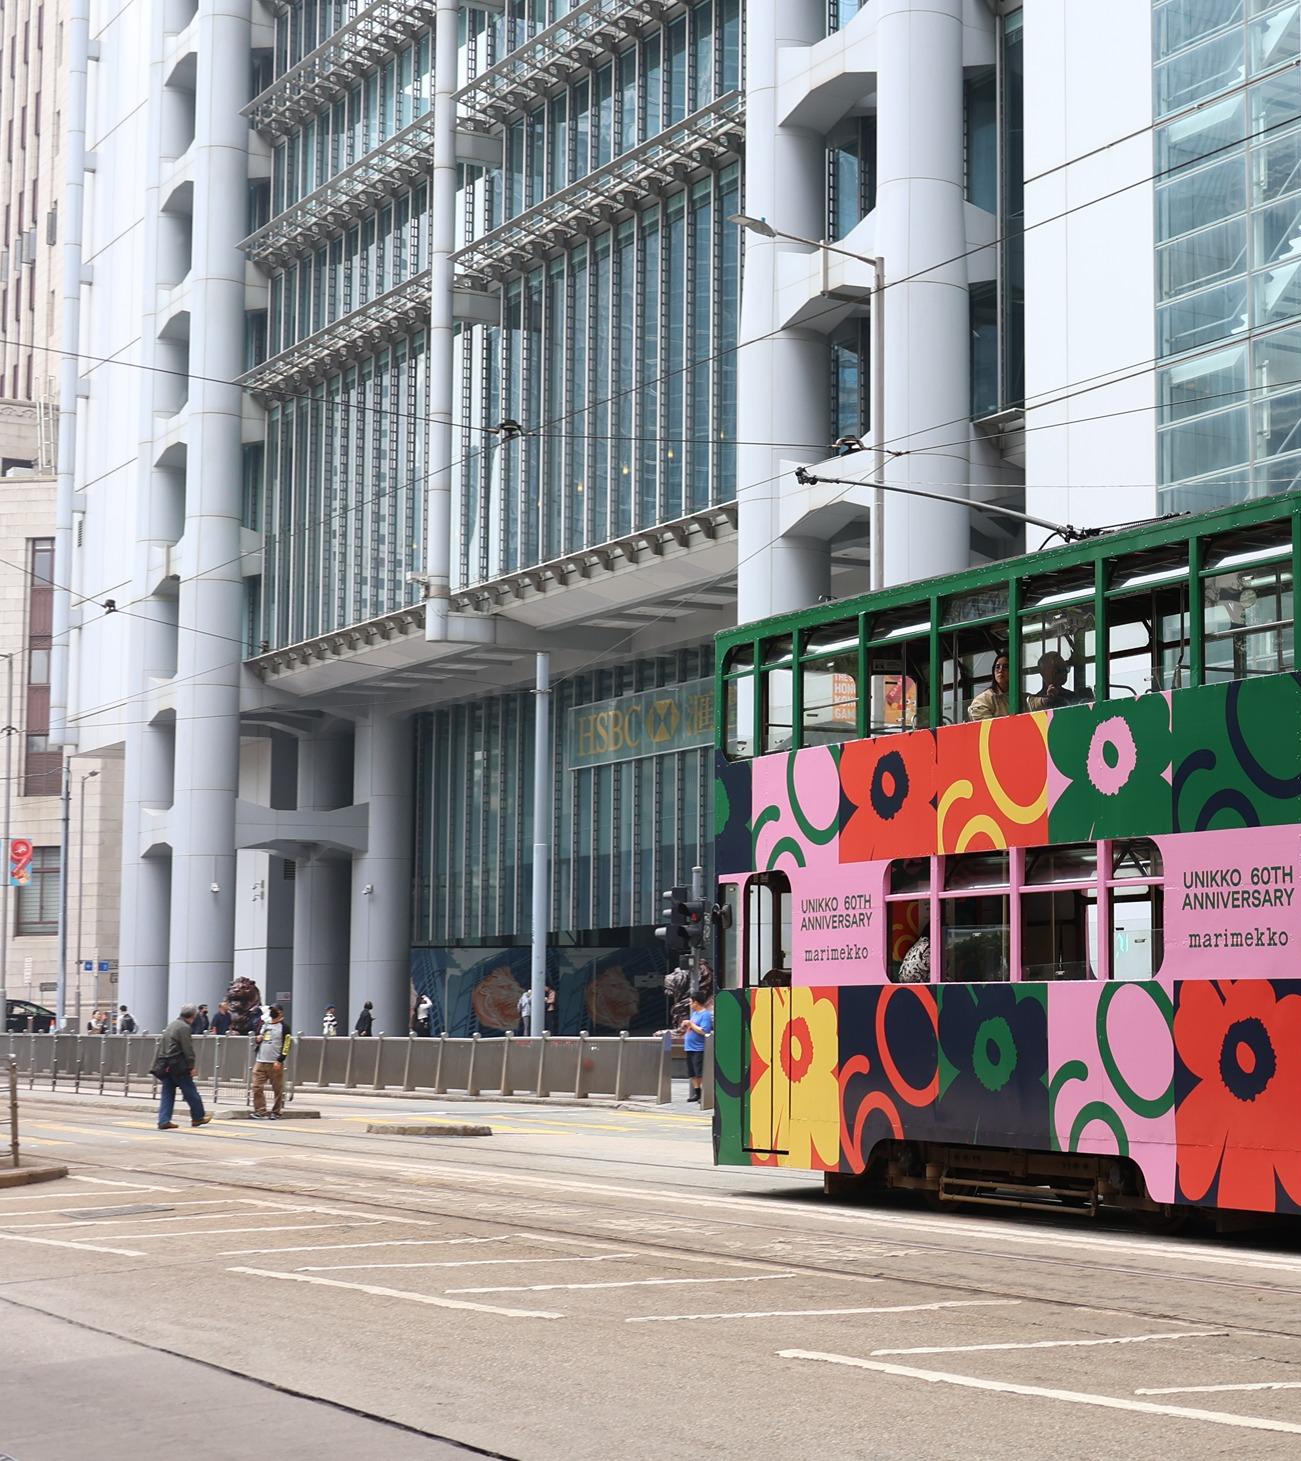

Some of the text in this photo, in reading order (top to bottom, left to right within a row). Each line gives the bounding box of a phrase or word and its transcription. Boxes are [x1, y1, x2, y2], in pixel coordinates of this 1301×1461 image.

[578, 704, 641, 757] HSBC
[1183, 865, 1293, 889] UNIKKO 60TH
[801, 894, 872, 914] UNIKKO 60TH
[1182, 888, 1295, 911] ANNIVERSARY
[800, 912, 873, 932] ANNIVERSARY
[1188, 927, 1289, 948] marimekko
[804, 944, 869, 962] marimekko
